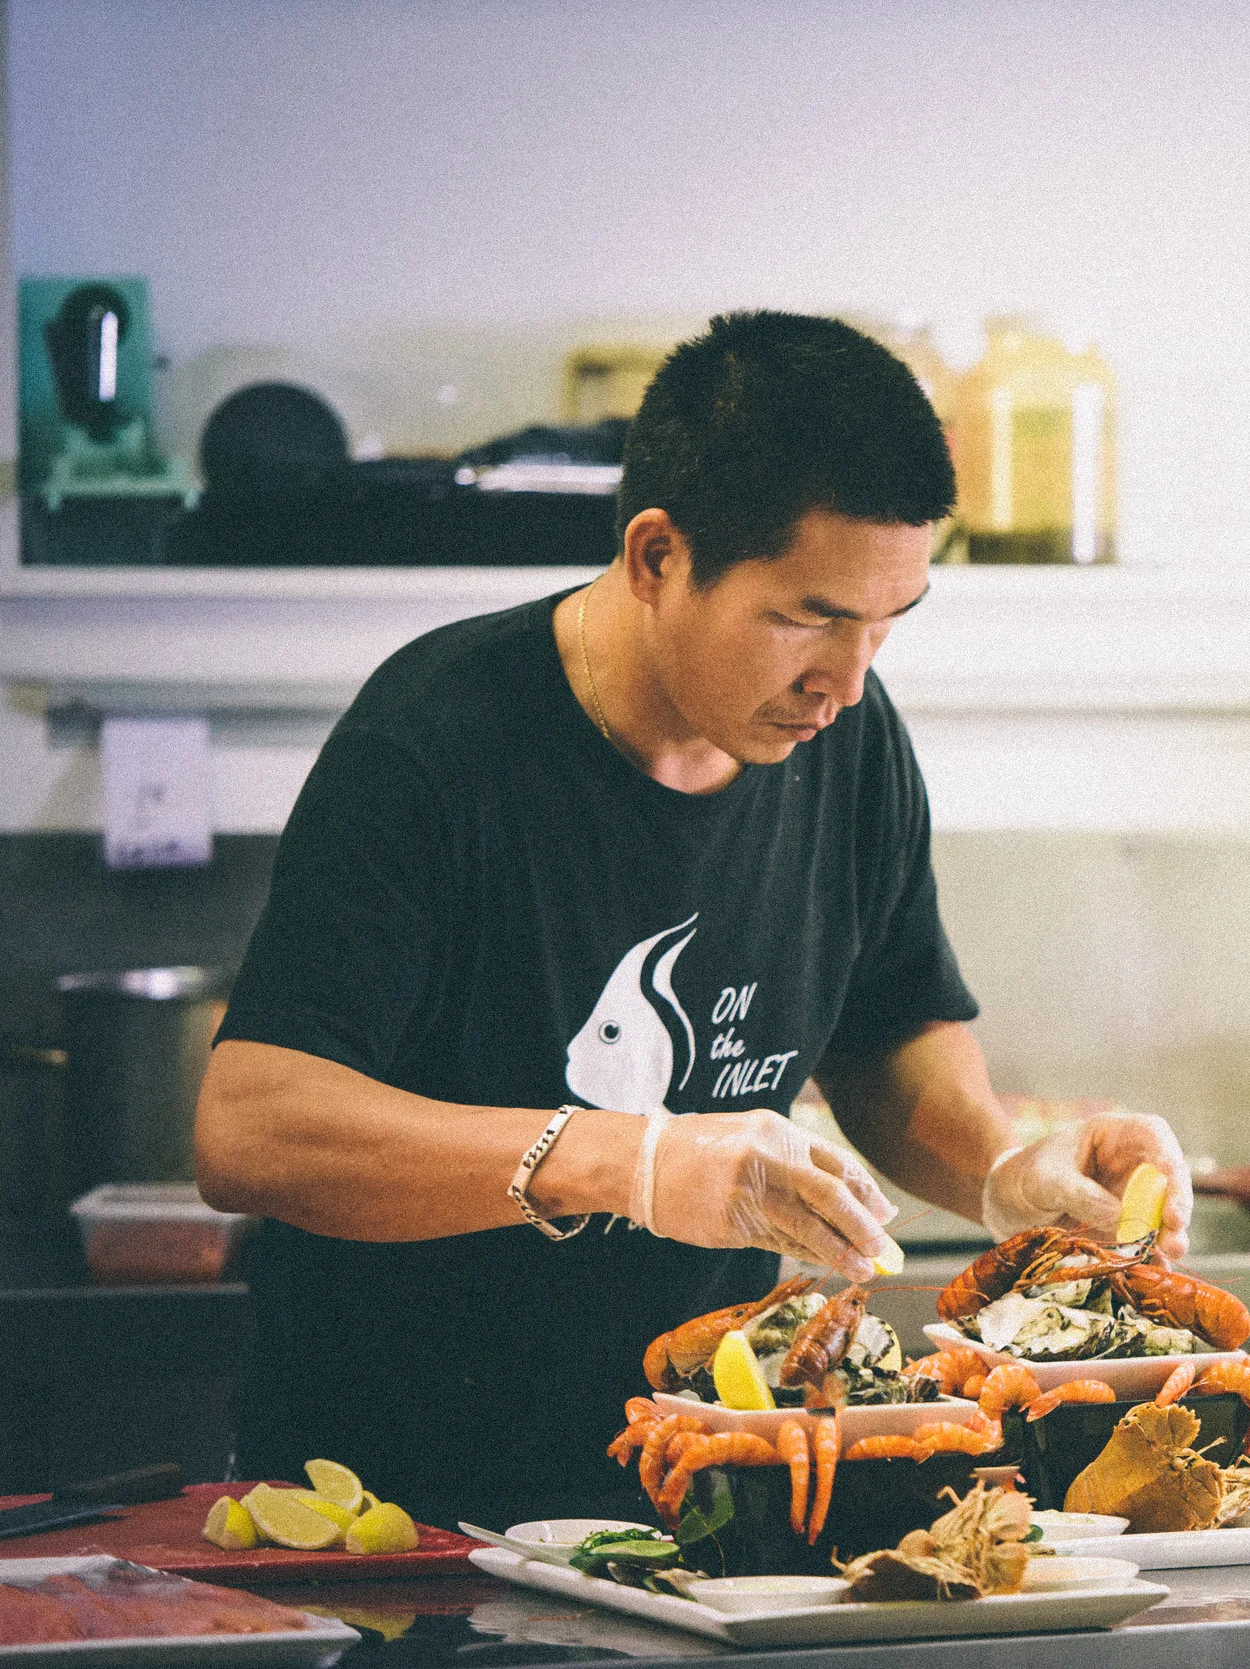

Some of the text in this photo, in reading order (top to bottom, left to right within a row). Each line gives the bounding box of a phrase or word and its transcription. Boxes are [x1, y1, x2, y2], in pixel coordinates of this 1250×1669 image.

[711, 982, 758, 1025] ON
[710, 1027, 746, 1060] the
[711, 1049, 799, 1098] INLET
